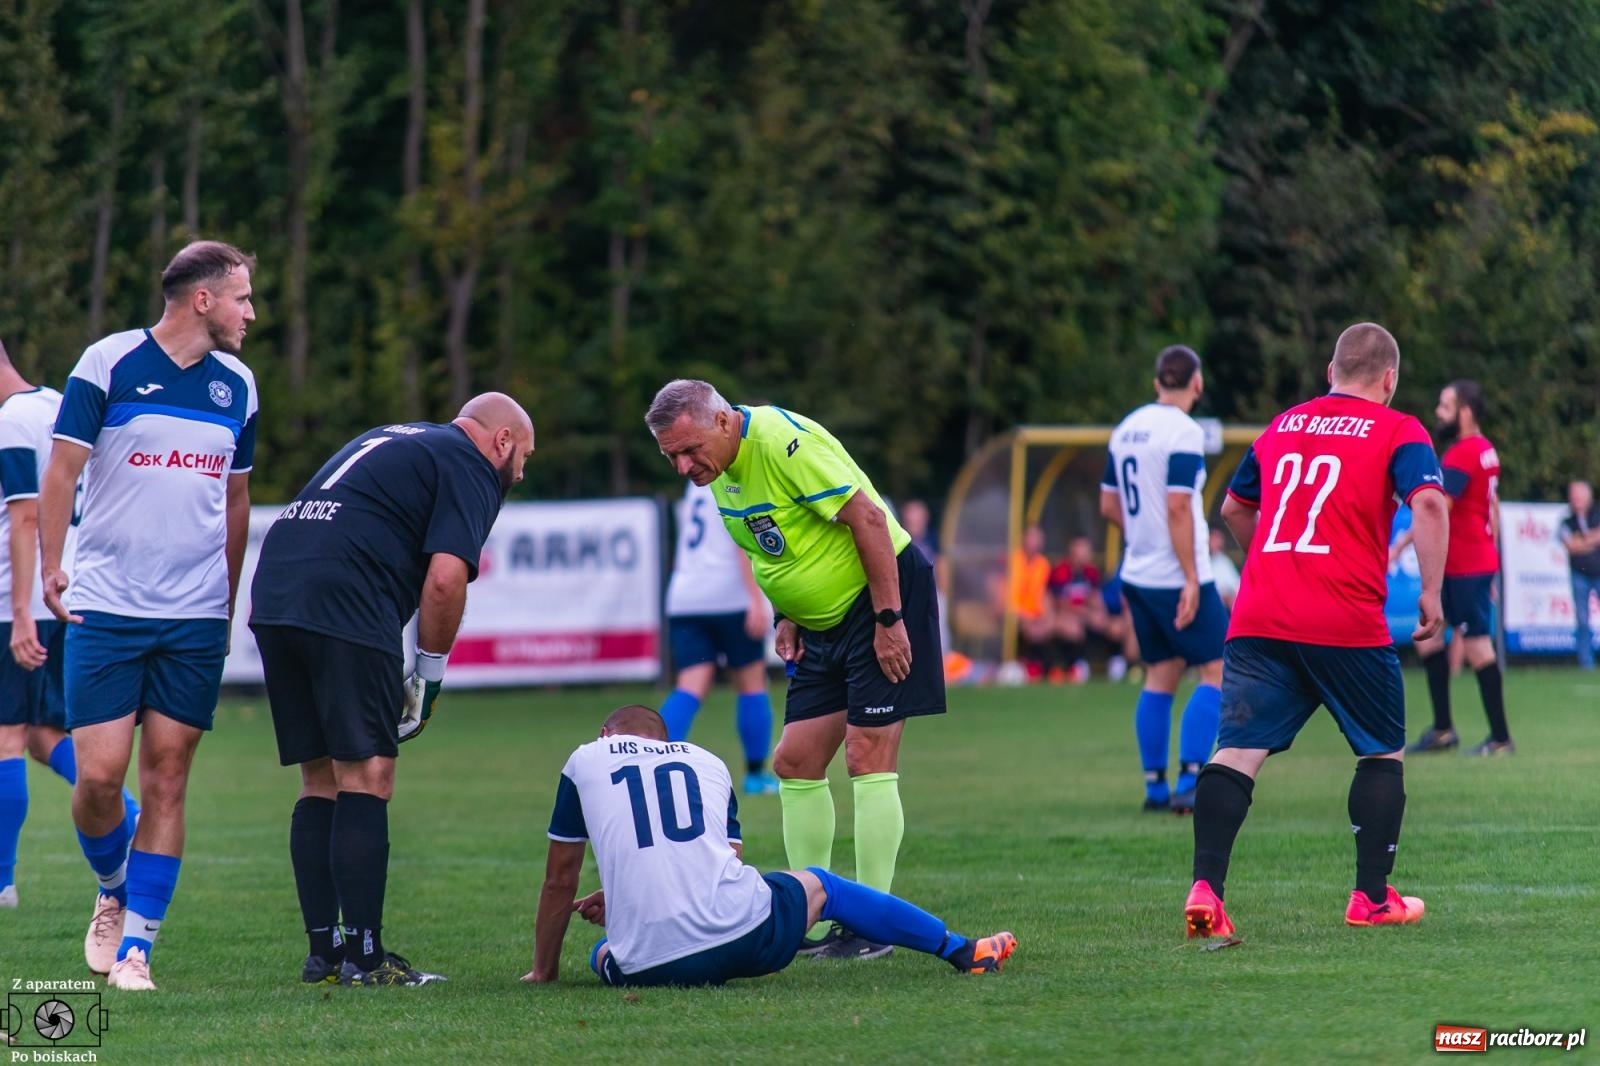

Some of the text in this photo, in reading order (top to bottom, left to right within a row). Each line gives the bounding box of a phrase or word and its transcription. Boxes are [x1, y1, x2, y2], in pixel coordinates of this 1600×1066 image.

[1277, 414, 1375, 438] LKS BRZEZIE
[320, 436, 393, 490] 1
[1122, 456, 1141, 517] 6
[299, 500, 342, 521] OCICE
[687, 498, 707, 549] 5
[1262, 452, 1342, 554] 22
[609, 742, 638, 754] LKS
[610, 761, 706, 849] 10
